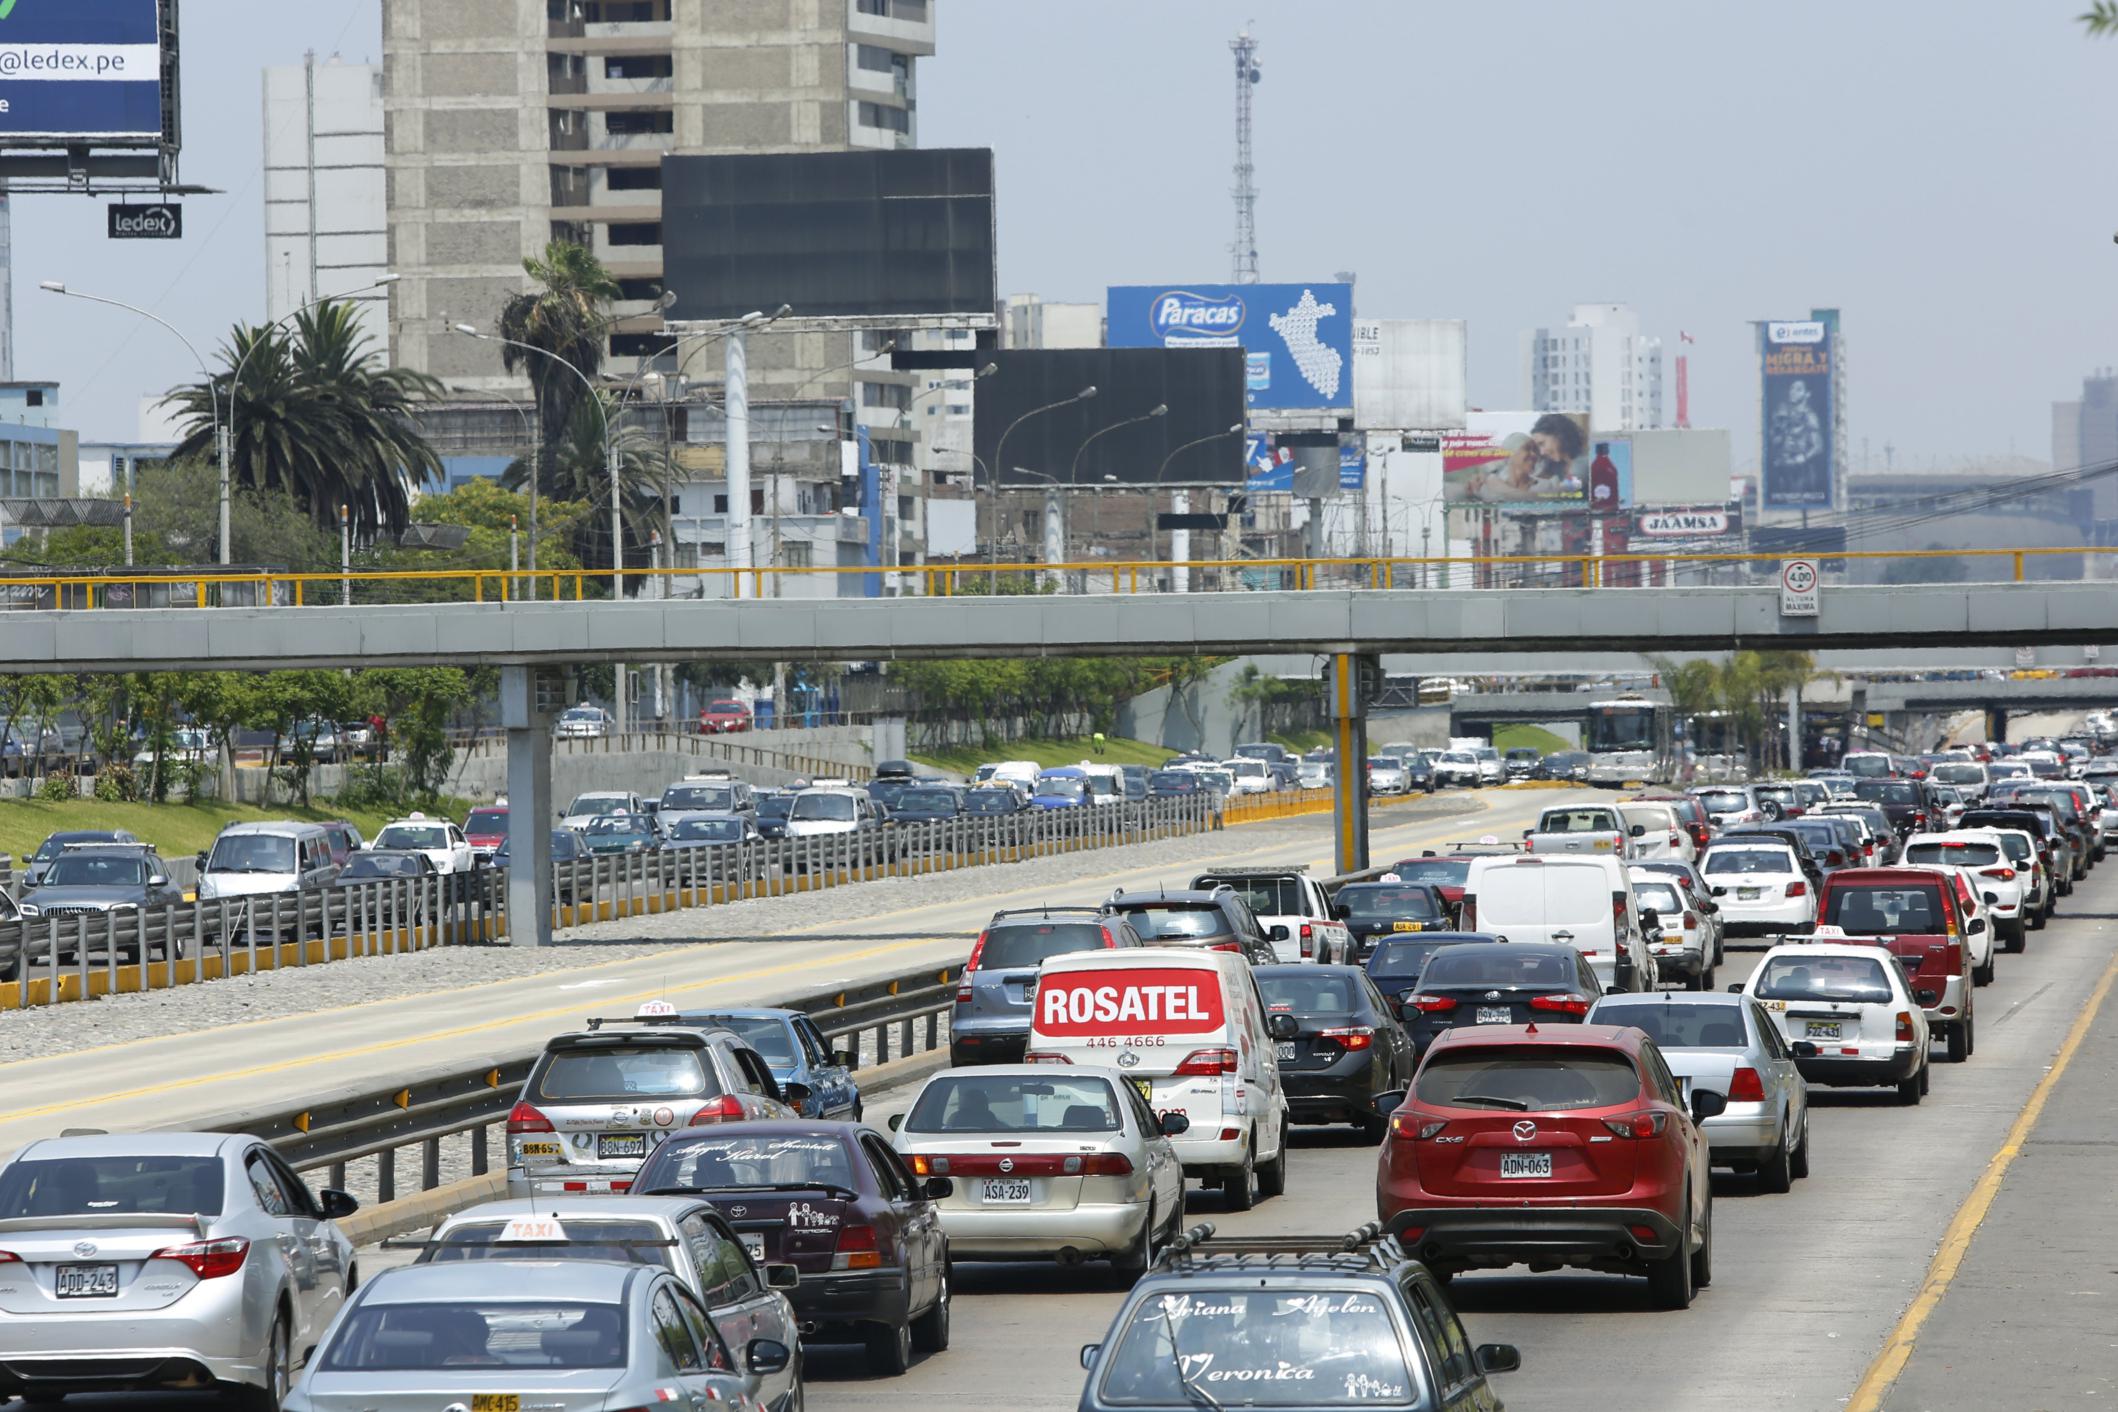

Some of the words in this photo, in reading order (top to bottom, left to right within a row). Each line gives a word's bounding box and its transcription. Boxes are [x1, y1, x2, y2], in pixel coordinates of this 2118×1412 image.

[1158, 298, 1240, 326] Paracas
[1649, 516, 1719, 530] JAAMSA
[1820, 927, 1839, 935] TAXI
[644, 1005, 671, 1014] TAXI
[1044, 985, 1209, 1024] ROSATEL
[1086, 1037, 1117, 1048] 446
[1124, 1036, 1165, 1047] 4666
[1502, 1159, 1550, 1175] ADN-063
[984, 1184, 1029, 1201] ASA-239
[512, 1223, 554, 1237] TAXI
[58, 1273, 115, 1294] ADD-243
[1143, 1294, 1246, 1322] Ariana
[1172, 1353, 1315, 1382] Veronica
[472, 1394, 519, 1412] AMC-415
